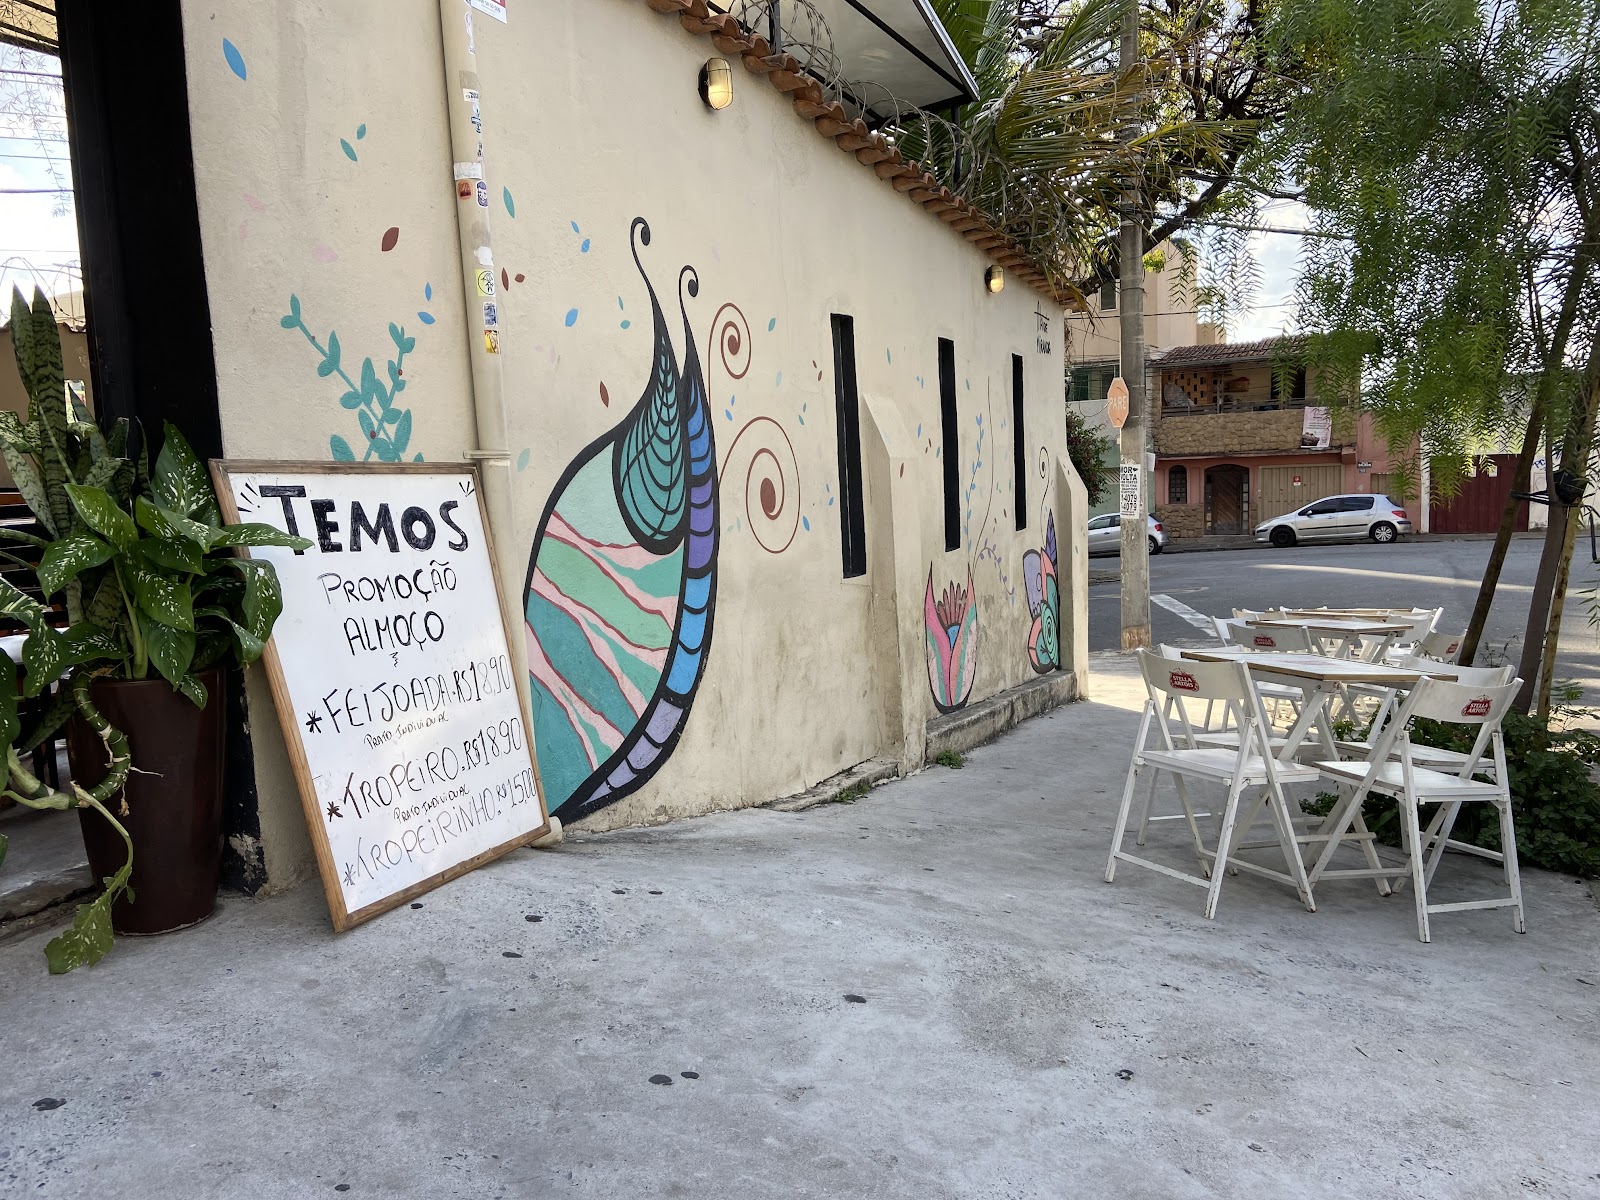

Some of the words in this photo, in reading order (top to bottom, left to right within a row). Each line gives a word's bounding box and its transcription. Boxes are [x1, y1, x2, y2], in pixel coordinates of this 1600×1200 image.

[1109, 396, 1127, 410] PARE
[258, 484, 469, 556] TEMOS
[317, 559, 457, 605] PROMOÇÃO
[343, 610, 445, 656] ALMOÇO
[1172, 675, 1192, 683] STELLA
[1174, 680, 1194, 688] ARTOIS
[363, 730, 393, 750] PRATO
[395, 711, 449, 739] INDIVIDUAL
[393, 804, 421, 824] PRATO
[421, 783, 470, 815] INDIVIDUAL
